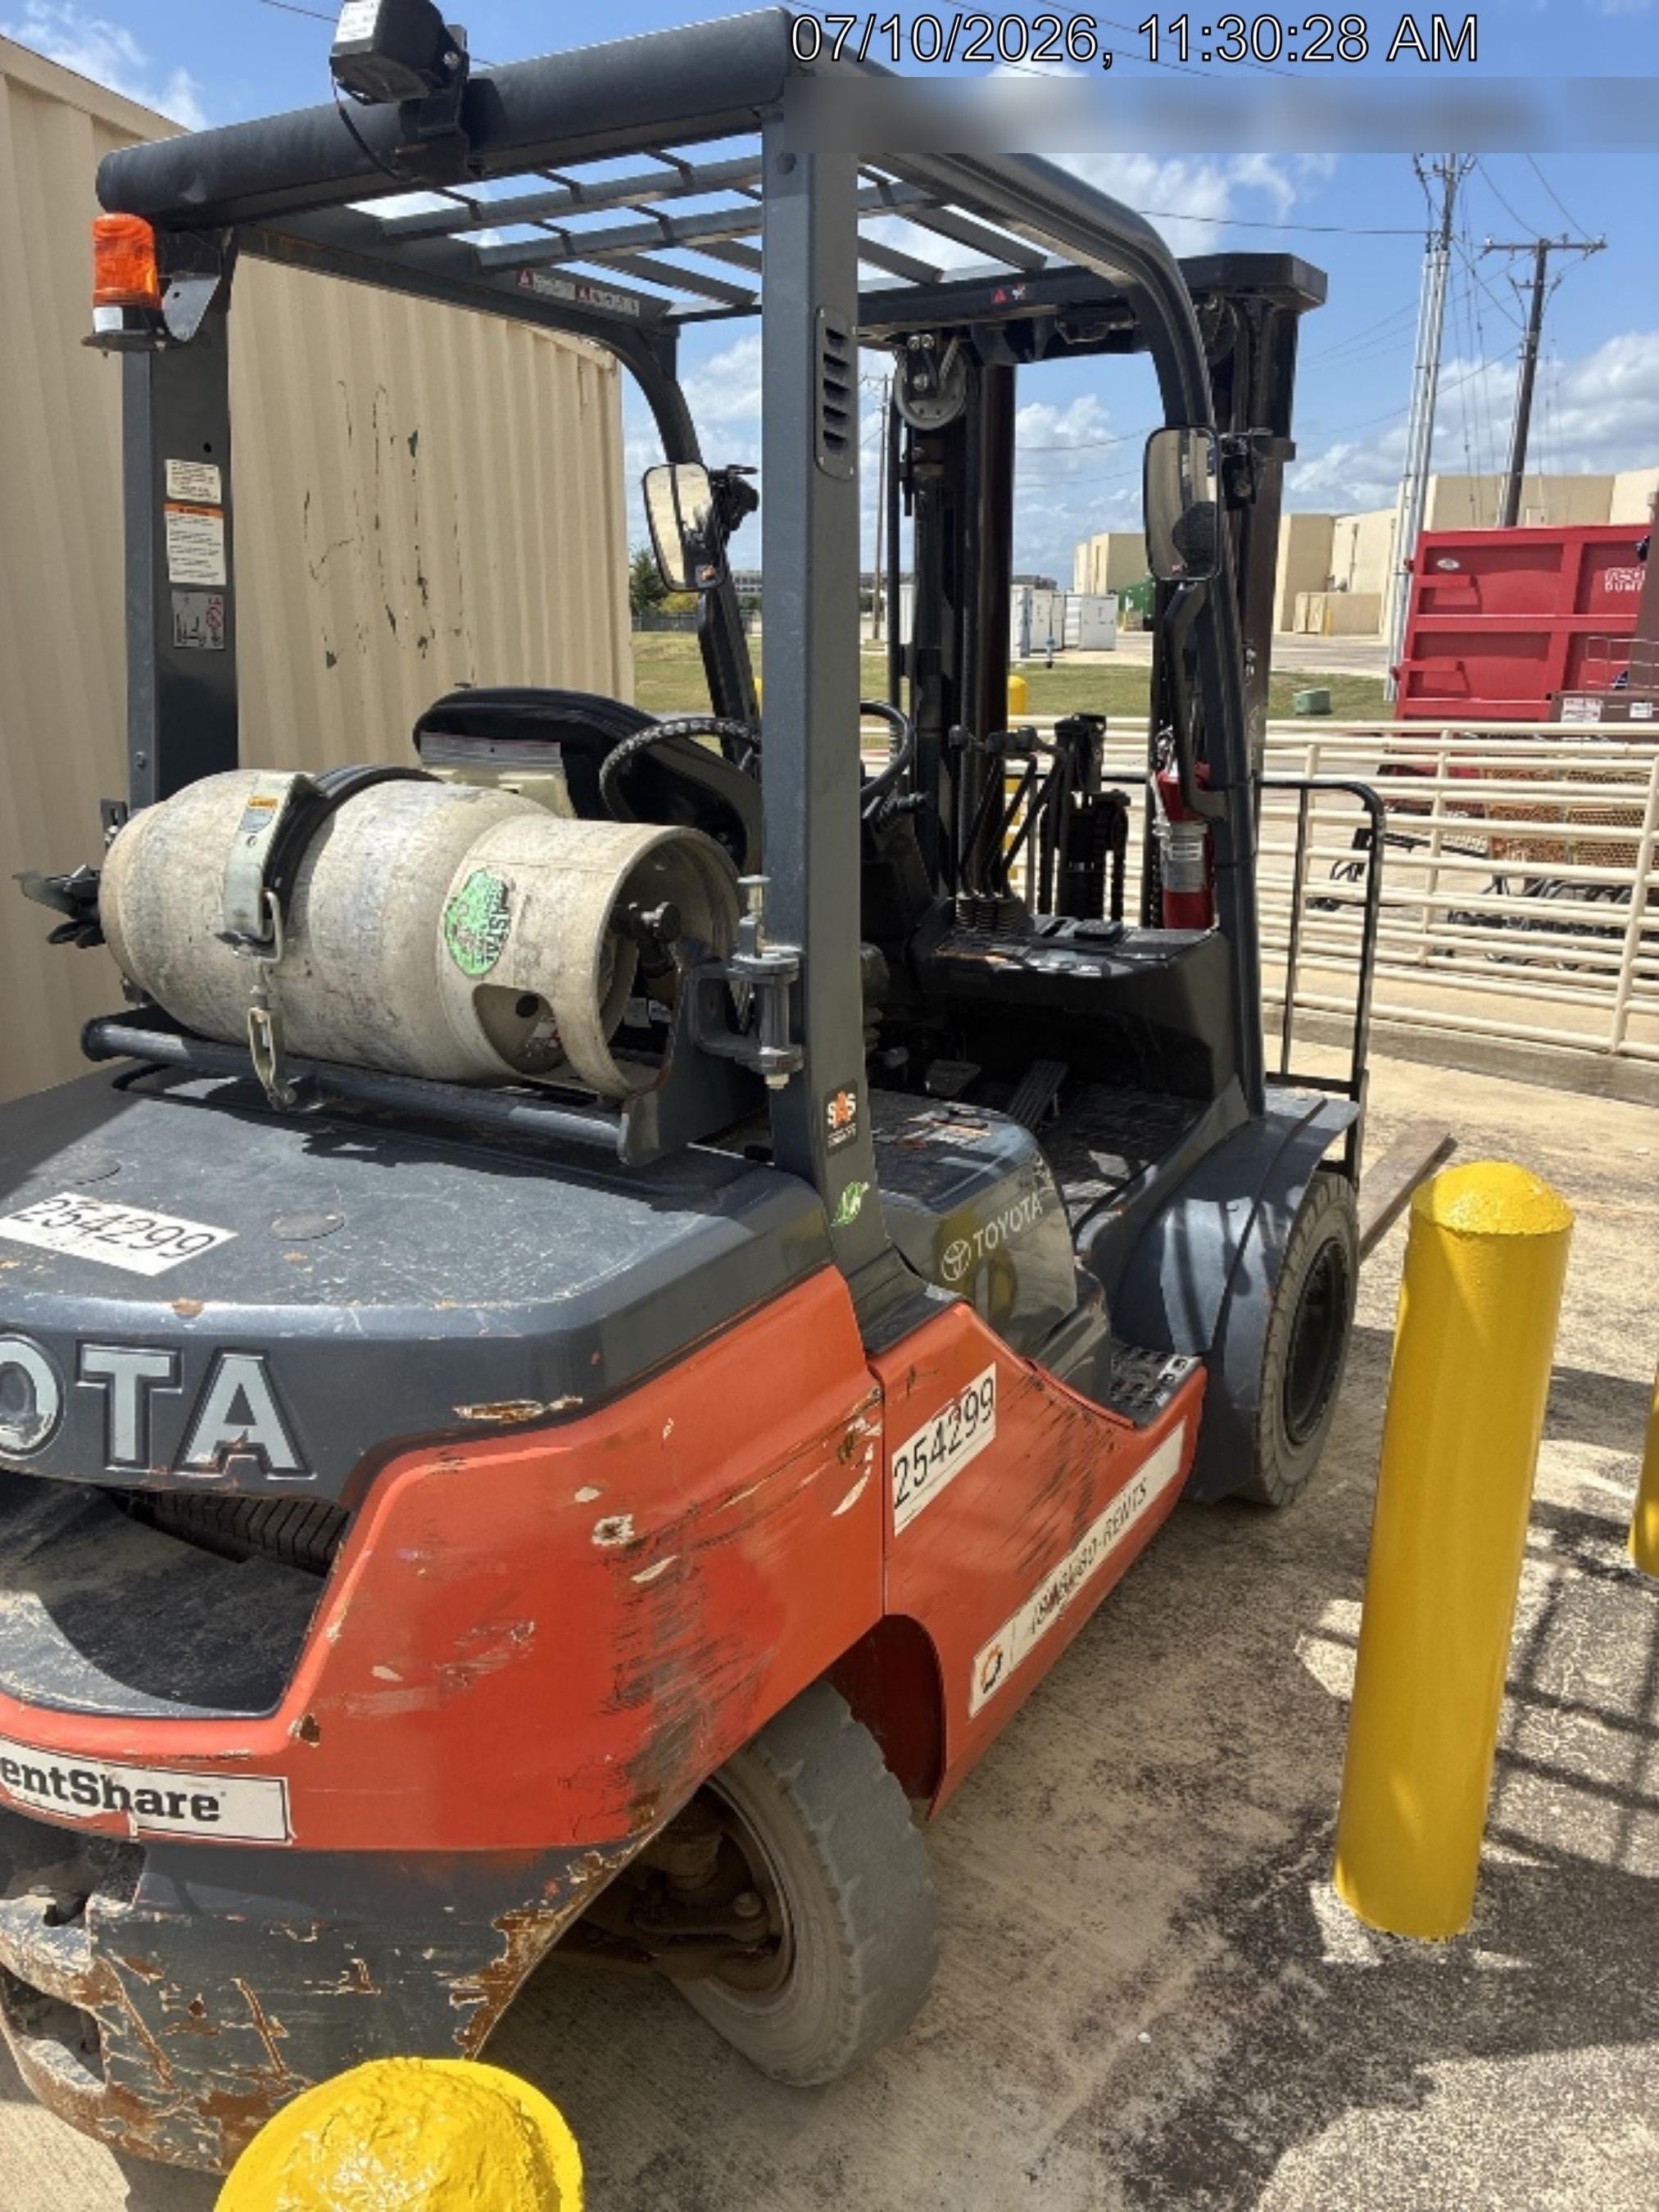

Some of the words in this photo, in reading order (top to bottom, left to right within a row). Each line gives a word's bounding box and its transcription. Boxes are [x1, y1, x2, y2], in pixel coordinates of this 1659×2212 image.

[10, 1199, 216, 1258] 254299
[972, 1191, 1043, 1258] TOYOTA
[0, 1334, 318, 1480] OTA
[894, 1376, 995, 1509] 254299
[0, 1757, 220, 1822] entShare
